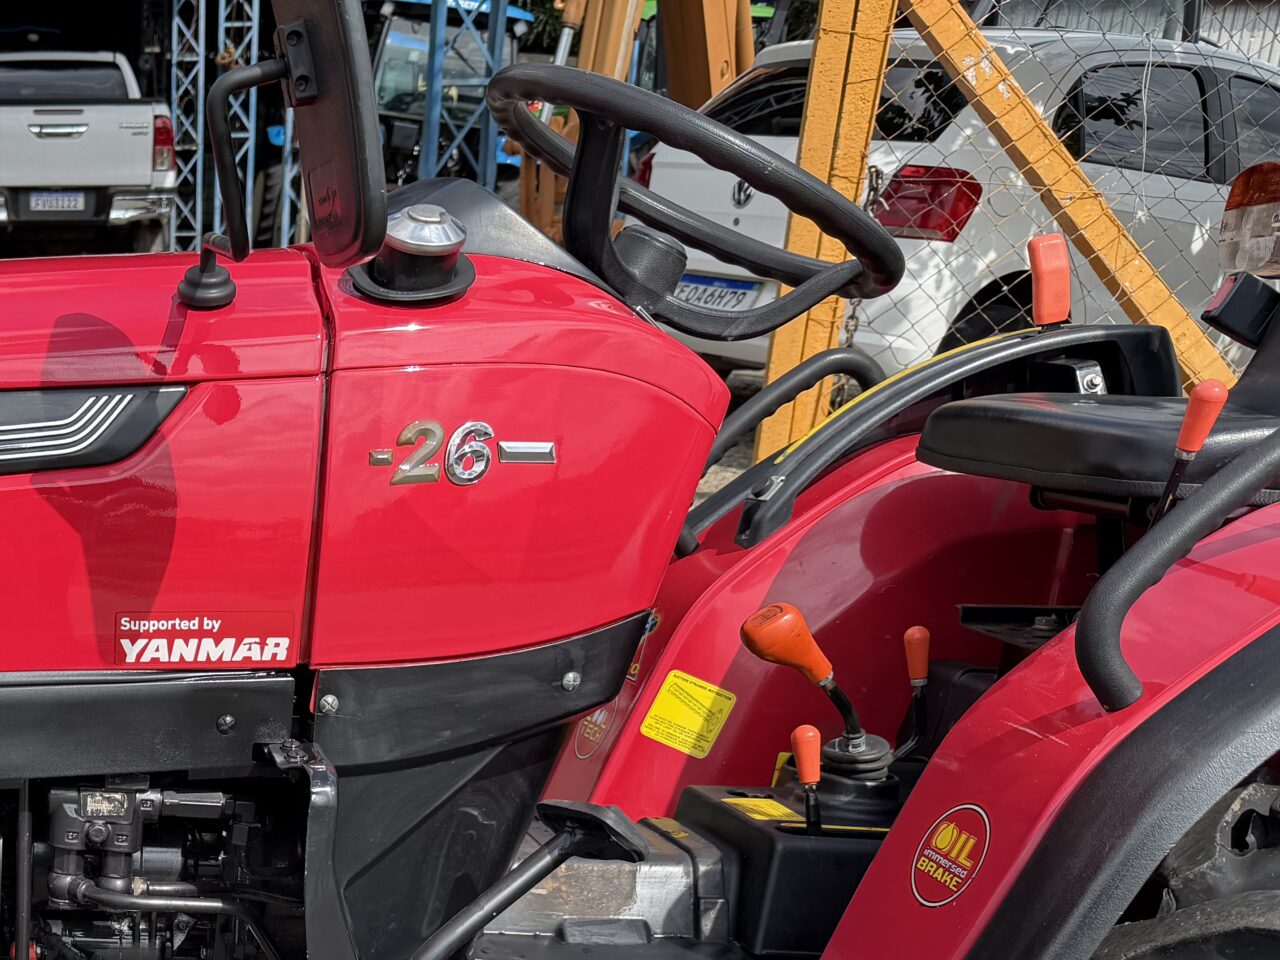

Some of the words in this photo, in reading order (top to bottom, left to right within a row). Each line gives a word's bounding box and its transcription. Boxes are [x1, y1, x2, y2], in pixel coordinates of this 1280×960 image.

[120, 617, 199, 633] Supported
[203, 617, 221, 632] by
[120, 637, 290, 663] YANMAR
[931, 821, 977, 870] OIL
[916, 856, 962, 892] BRAKE
[923, 847, 968, 879] immersed
